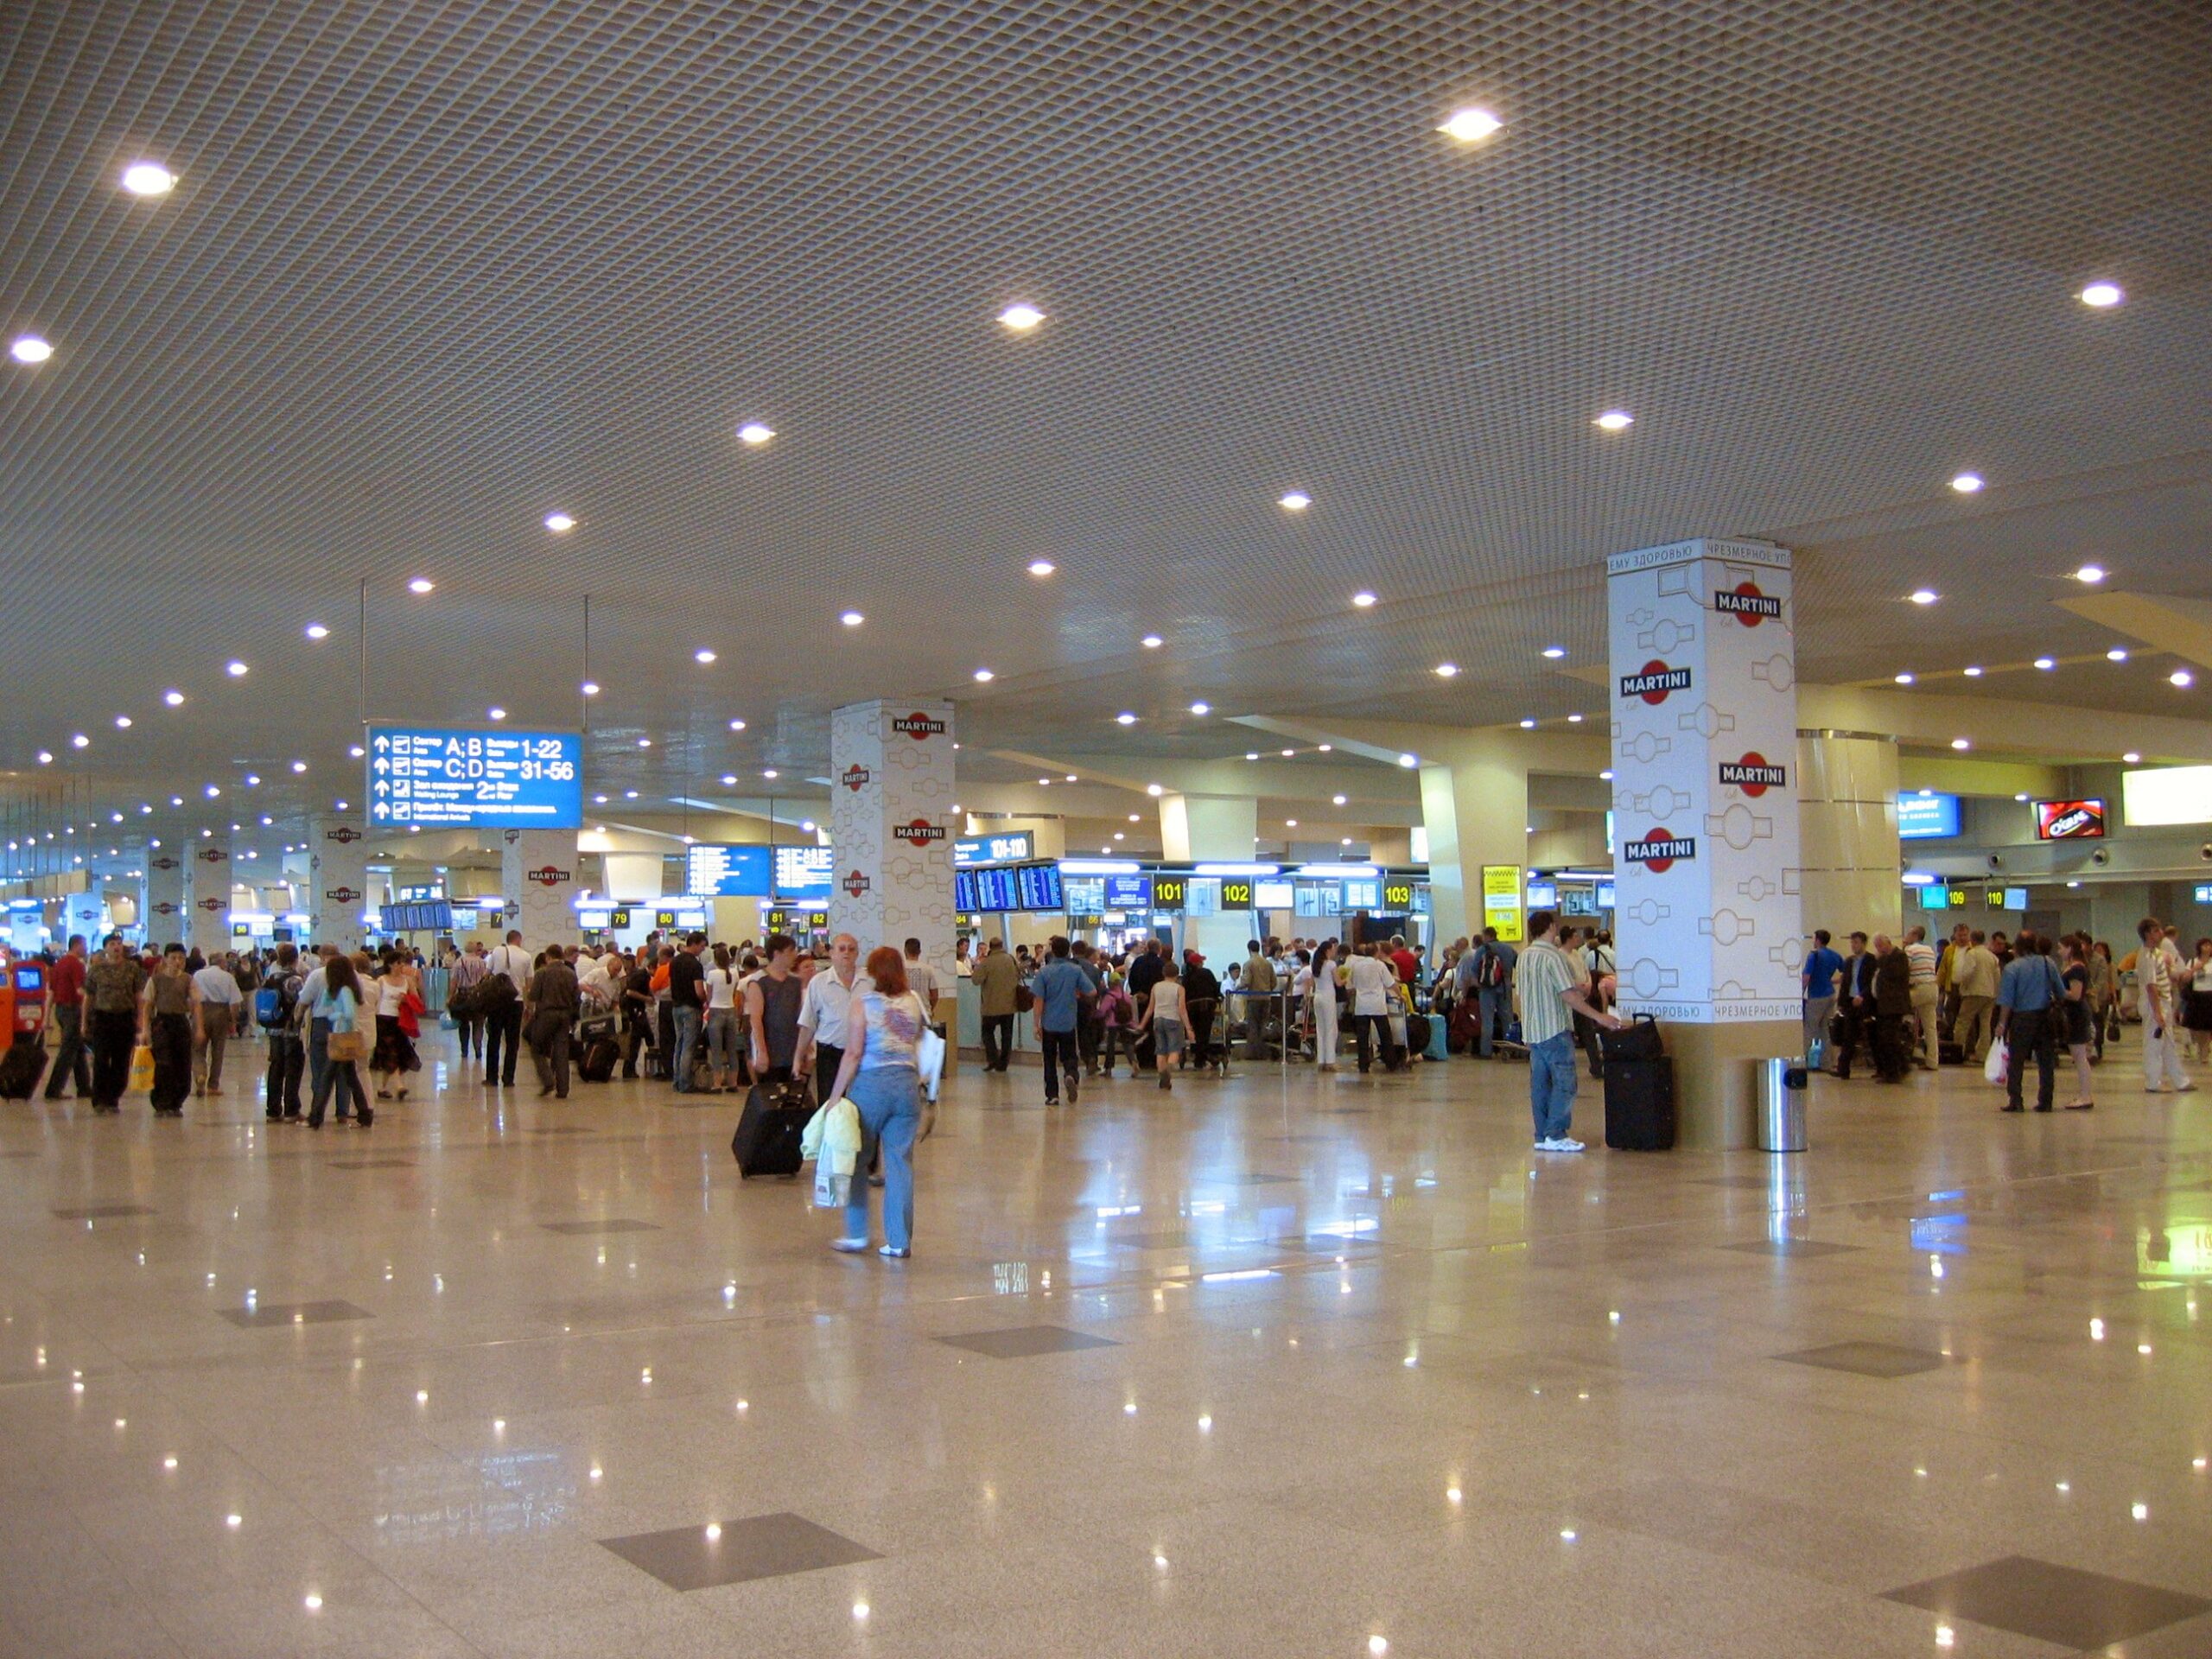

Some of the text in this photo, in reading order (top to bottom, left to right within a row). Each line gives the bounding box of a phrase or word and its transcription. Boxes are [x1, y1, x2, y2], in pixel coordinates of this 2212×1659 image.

[1633, 545, 1693, 567] ЗДОРОВЬЮ
[1707, 543, 1772, 562] ЧРЕЗМЕРНОЕ
[1718, 593, 1778, 615] MARTINI
[1623, 671, 1687, 694] MARTINI
[895, 721, 943, 733] MARTINI
[521, 739, 563, 759] 1-22
[519, 760, 574, 780] 31-56
[1722, 766, 1783, 784] MARTINI
[896, 826, 944, 838] MARTINI
[990, 837, 1027, 859] 101-110
[1627, 840, 1692, 860] MARTINI
[530, 872, 569, 880] MARTINI
[1156, 883, 1181, 900] 101
[1223, 885, 1249, 902] 102
[1385, 887, 1409, 903] 103
[1948, 891, 1965, 905] 109
[1987, 892, 2002, 905] 110
[614, 913, 627, 924] 79
[659, 913, 672, 924] 80
[772, 912, 783, 923] 81
[812, 912, 824, 924] 82
[1714, 1005, 1780, 1018] ЧРЕЗМЕРНОЕ
